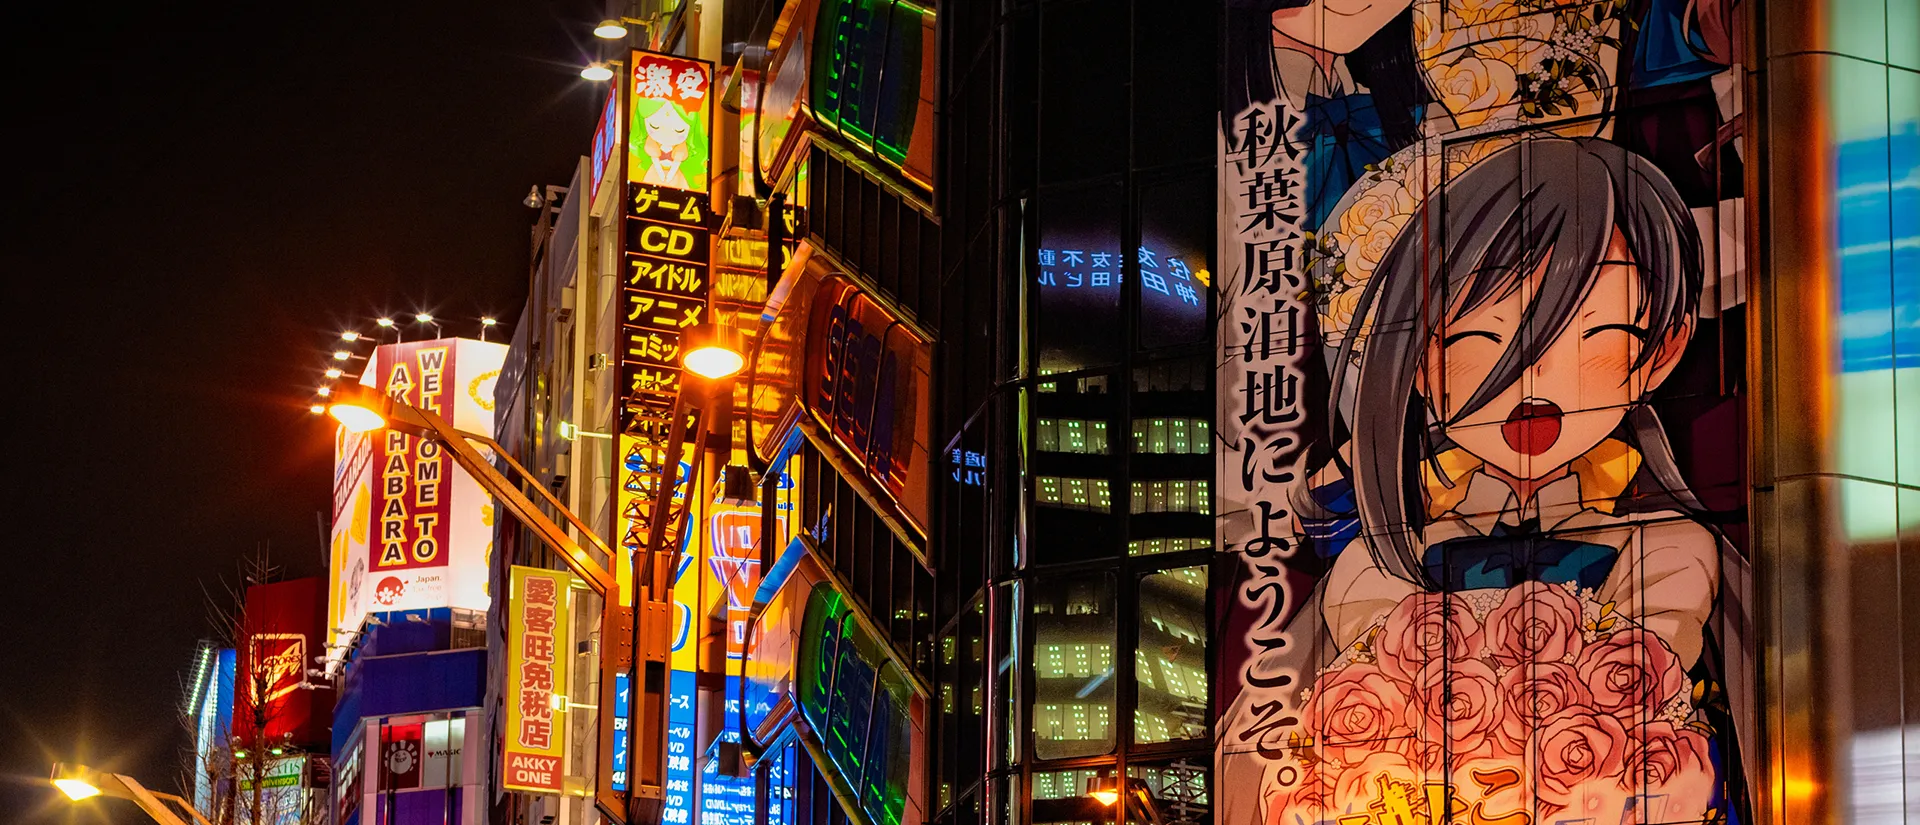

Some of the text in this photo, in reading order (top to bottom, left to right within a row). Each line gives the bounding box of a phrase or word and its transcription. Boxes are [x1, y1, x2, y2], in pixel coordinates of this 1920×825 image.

[635, 63, 705, 99] 激安
[635, 187, 701, 223] ゲーム
[640, 226, 694, 256] CD
[631, 260, 702, 293] アイドル
[628, 295, 703, 329] アニメ
[629, 335, 679, 362] コミッ
[631, 369, 679, 398] ホビ
[418, 349, 446, 505] WELOME
[1239, 103, 1300, 786] 秋葉原泊地にようこそ。
[382, 365, 410, 564] AKHABARA
[415, 516, 436, 560] TO
[520, 577, 555, 748] 愛客旺免税店
[512, 755, 557, 772] AKKY
[516, 769, 552, 785] ONE
